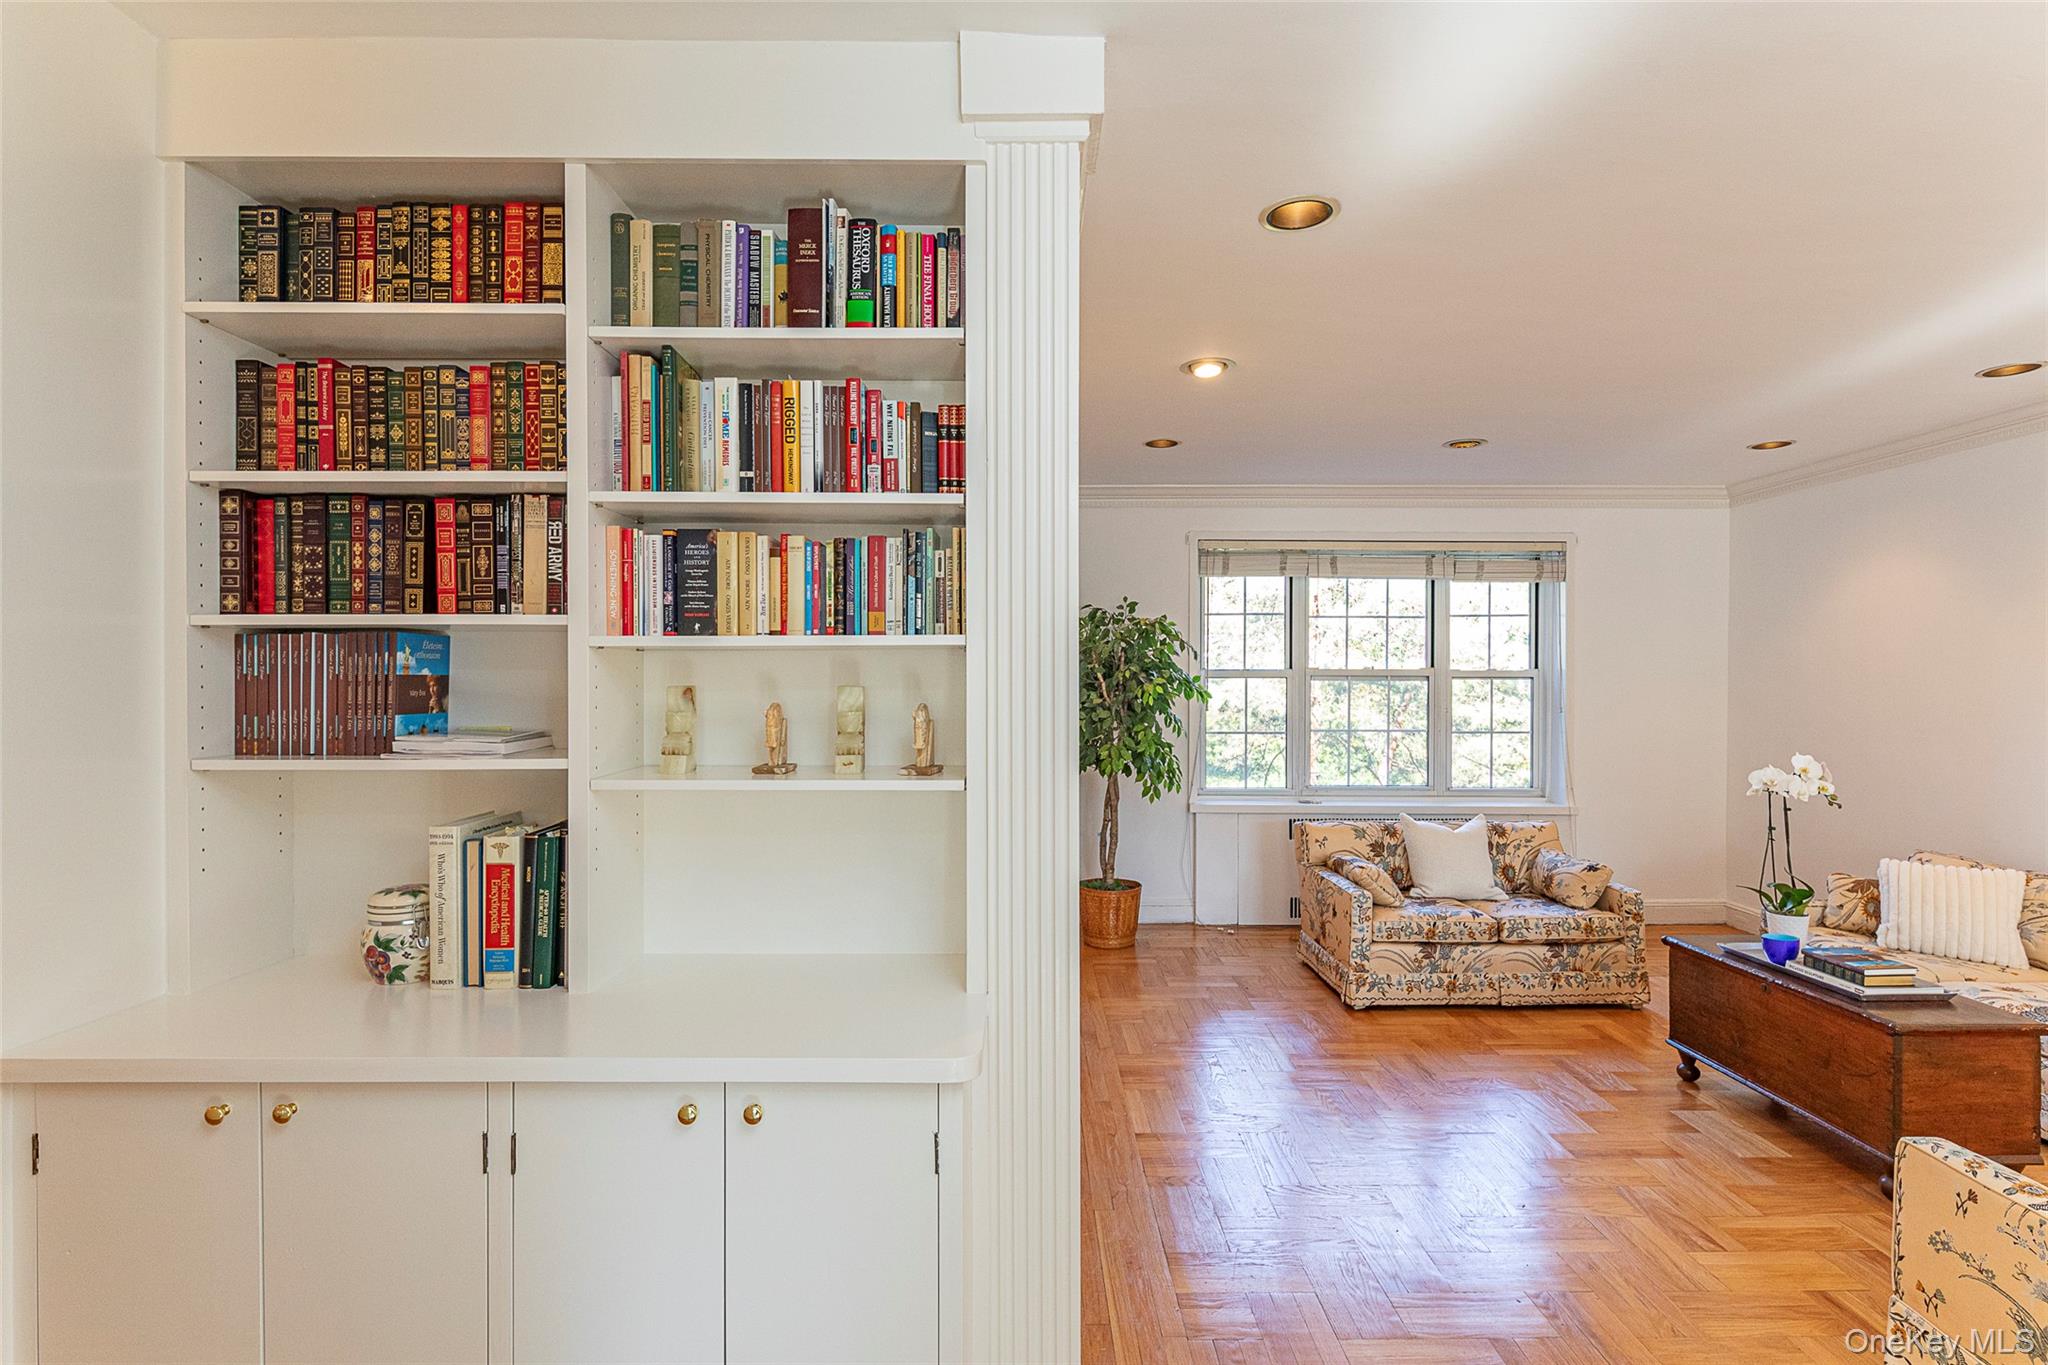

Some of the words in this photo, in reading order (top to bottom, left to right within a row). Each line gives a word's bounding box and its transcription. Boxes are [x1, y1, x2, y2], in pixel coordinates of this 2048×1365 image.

[749, 235, 760, 268] SHADOW
[852, 227, 861, 289] THESAURUS
[862, 227, 871, 273] OXFORD
[923, 254, 932, 274] THE
[749, 271, 760, 305] MASTERS
[948, 252, 959, 292] Bilderberg
[923, 275, 932, 303] FINAL
[948, 293, 959, 315] Group
[630, 385, 639, 436] HUNGARY
[642, 403, 650, 421] WORLD
[784, 397, 796, 444] RIGGED
[642, 423, 650, 436] WAR
[687, 432, 695, 479] Civilization
[548, 547, 562, 581] ARMY
[609, 549, 618, 597] SOMETHING
[609, 601, 618, 618] NEW
[437, 853, 446, 874] Who's
[435, 892, 446, 902] of
[437, 875, 446, 891] Who
[501, 867, 510, 900] Medical
[437, 902, 446, 936] American
[489, 879, 500, 934] Encyclopedia
[501, 901, 510, 917] and
[501, 918, 510, 946] Health
[437, 937, 446, 964] Women
